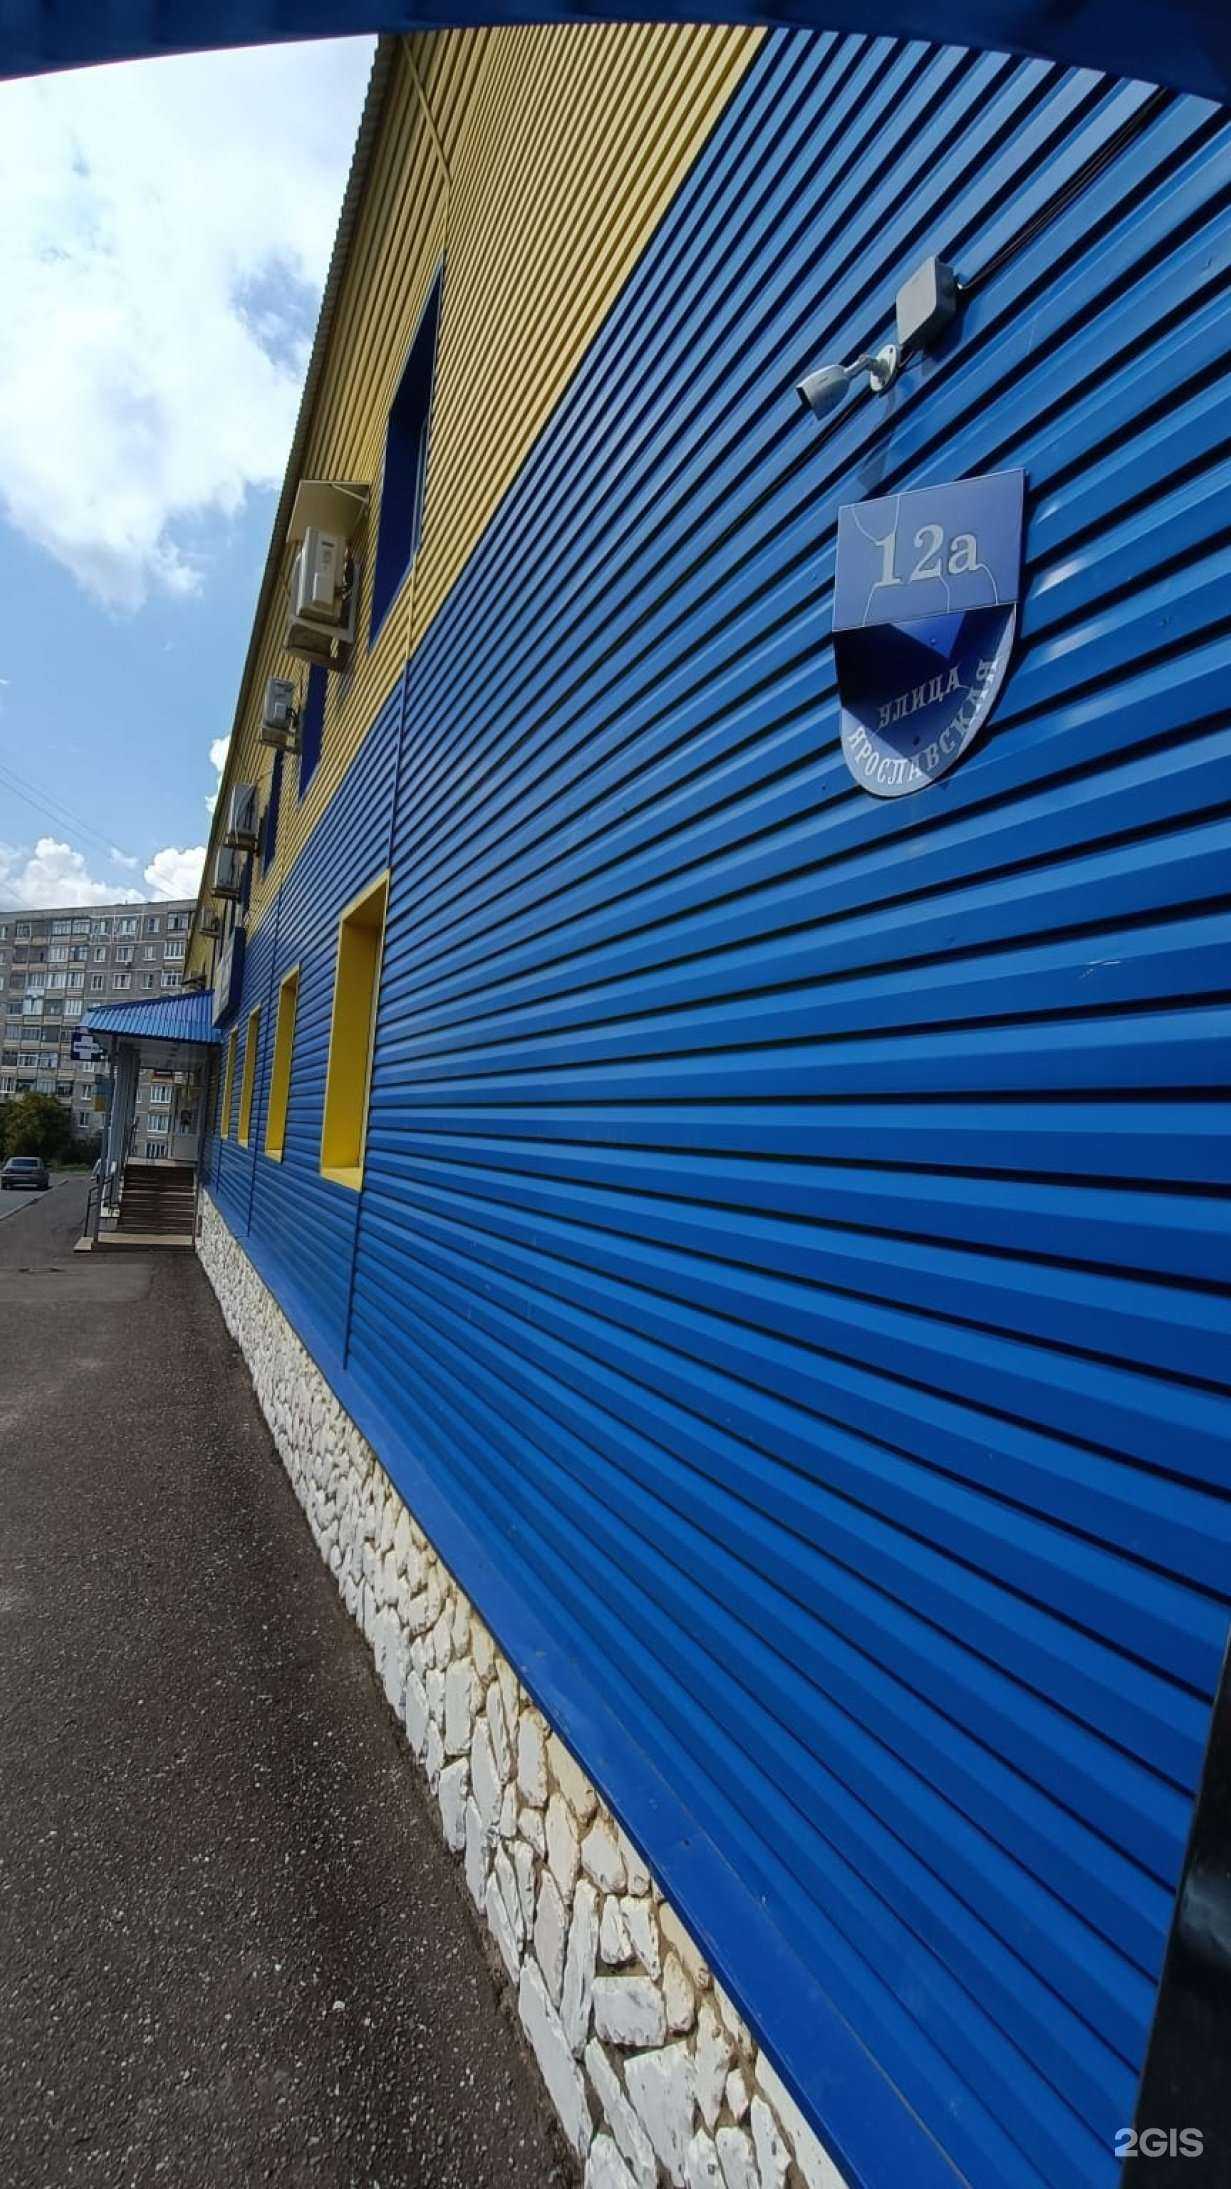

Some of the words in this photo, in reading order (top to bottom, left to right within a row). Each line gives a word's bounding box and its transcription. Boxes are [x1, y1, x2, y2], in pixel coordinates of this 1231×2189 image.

[874, 524, 980, 588] 12а
[848, 659, 997, 785] ЯРОСЛАВСКАЯ
[876, 665, 961, 730] УЛИЦА
